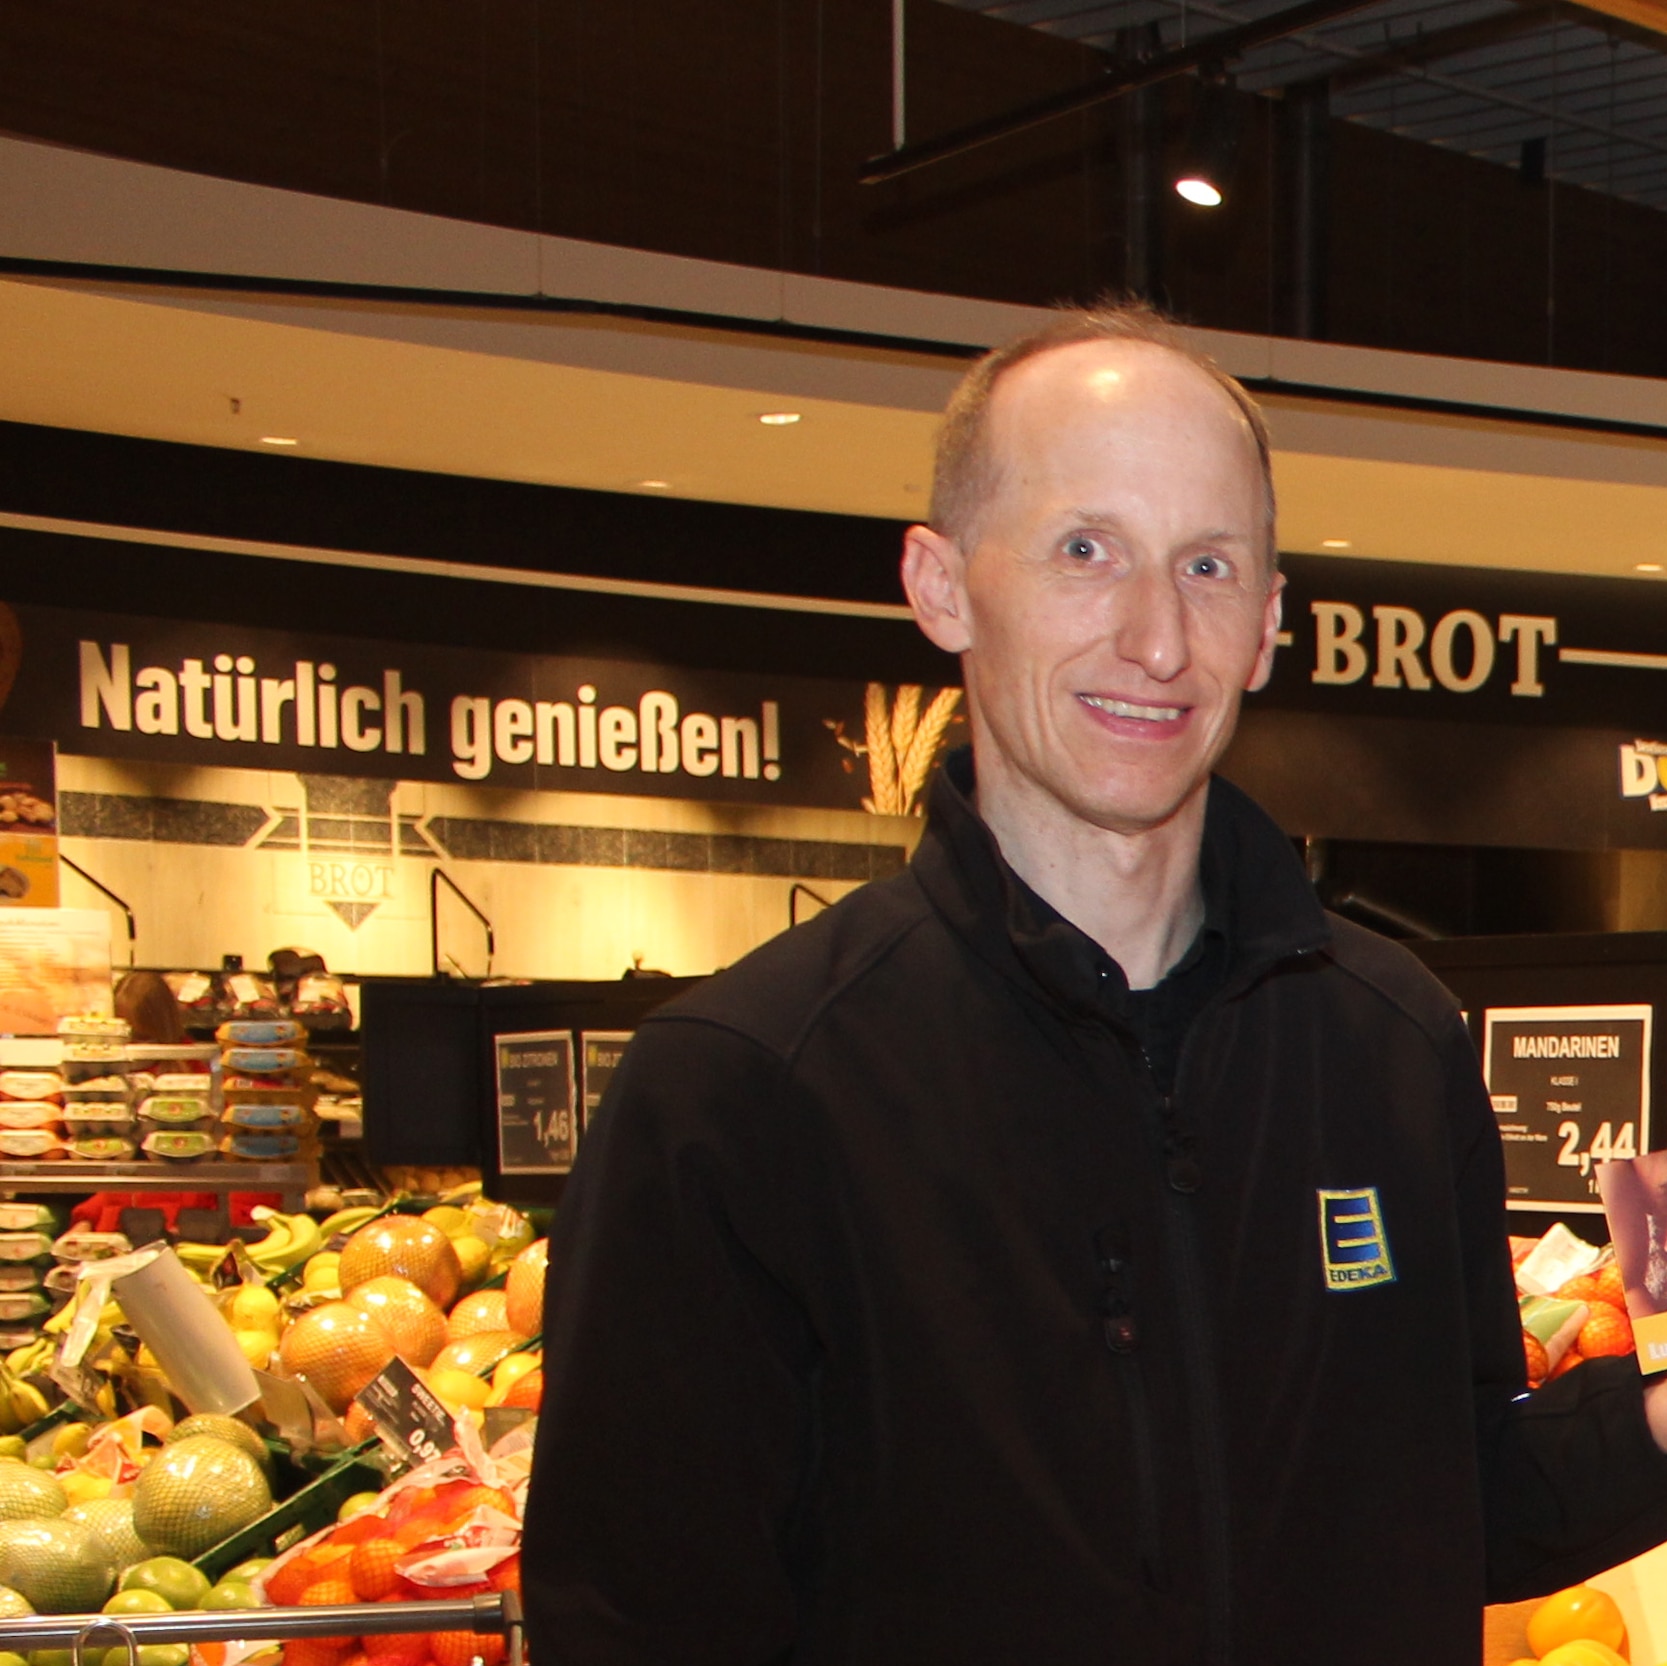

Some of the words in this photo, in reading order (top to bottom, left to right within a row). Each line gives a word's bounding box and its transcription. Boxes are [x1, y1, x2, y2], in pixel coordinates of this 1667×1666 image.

[1311, 601, 1556, 697] BROT
[78, 640, 427, 756] Natürlich
[450, 684, 782, 782] genießen!
[309, 862, 395, 898] BROT
[1513, 1035, 1620, 1058] MANDARINEN
[533, 1109, 569, 1148] 1,46
[1557, 1120, 1637, 1177] 2,44
[1329, 1264, 1388, 1283] EDEKA
